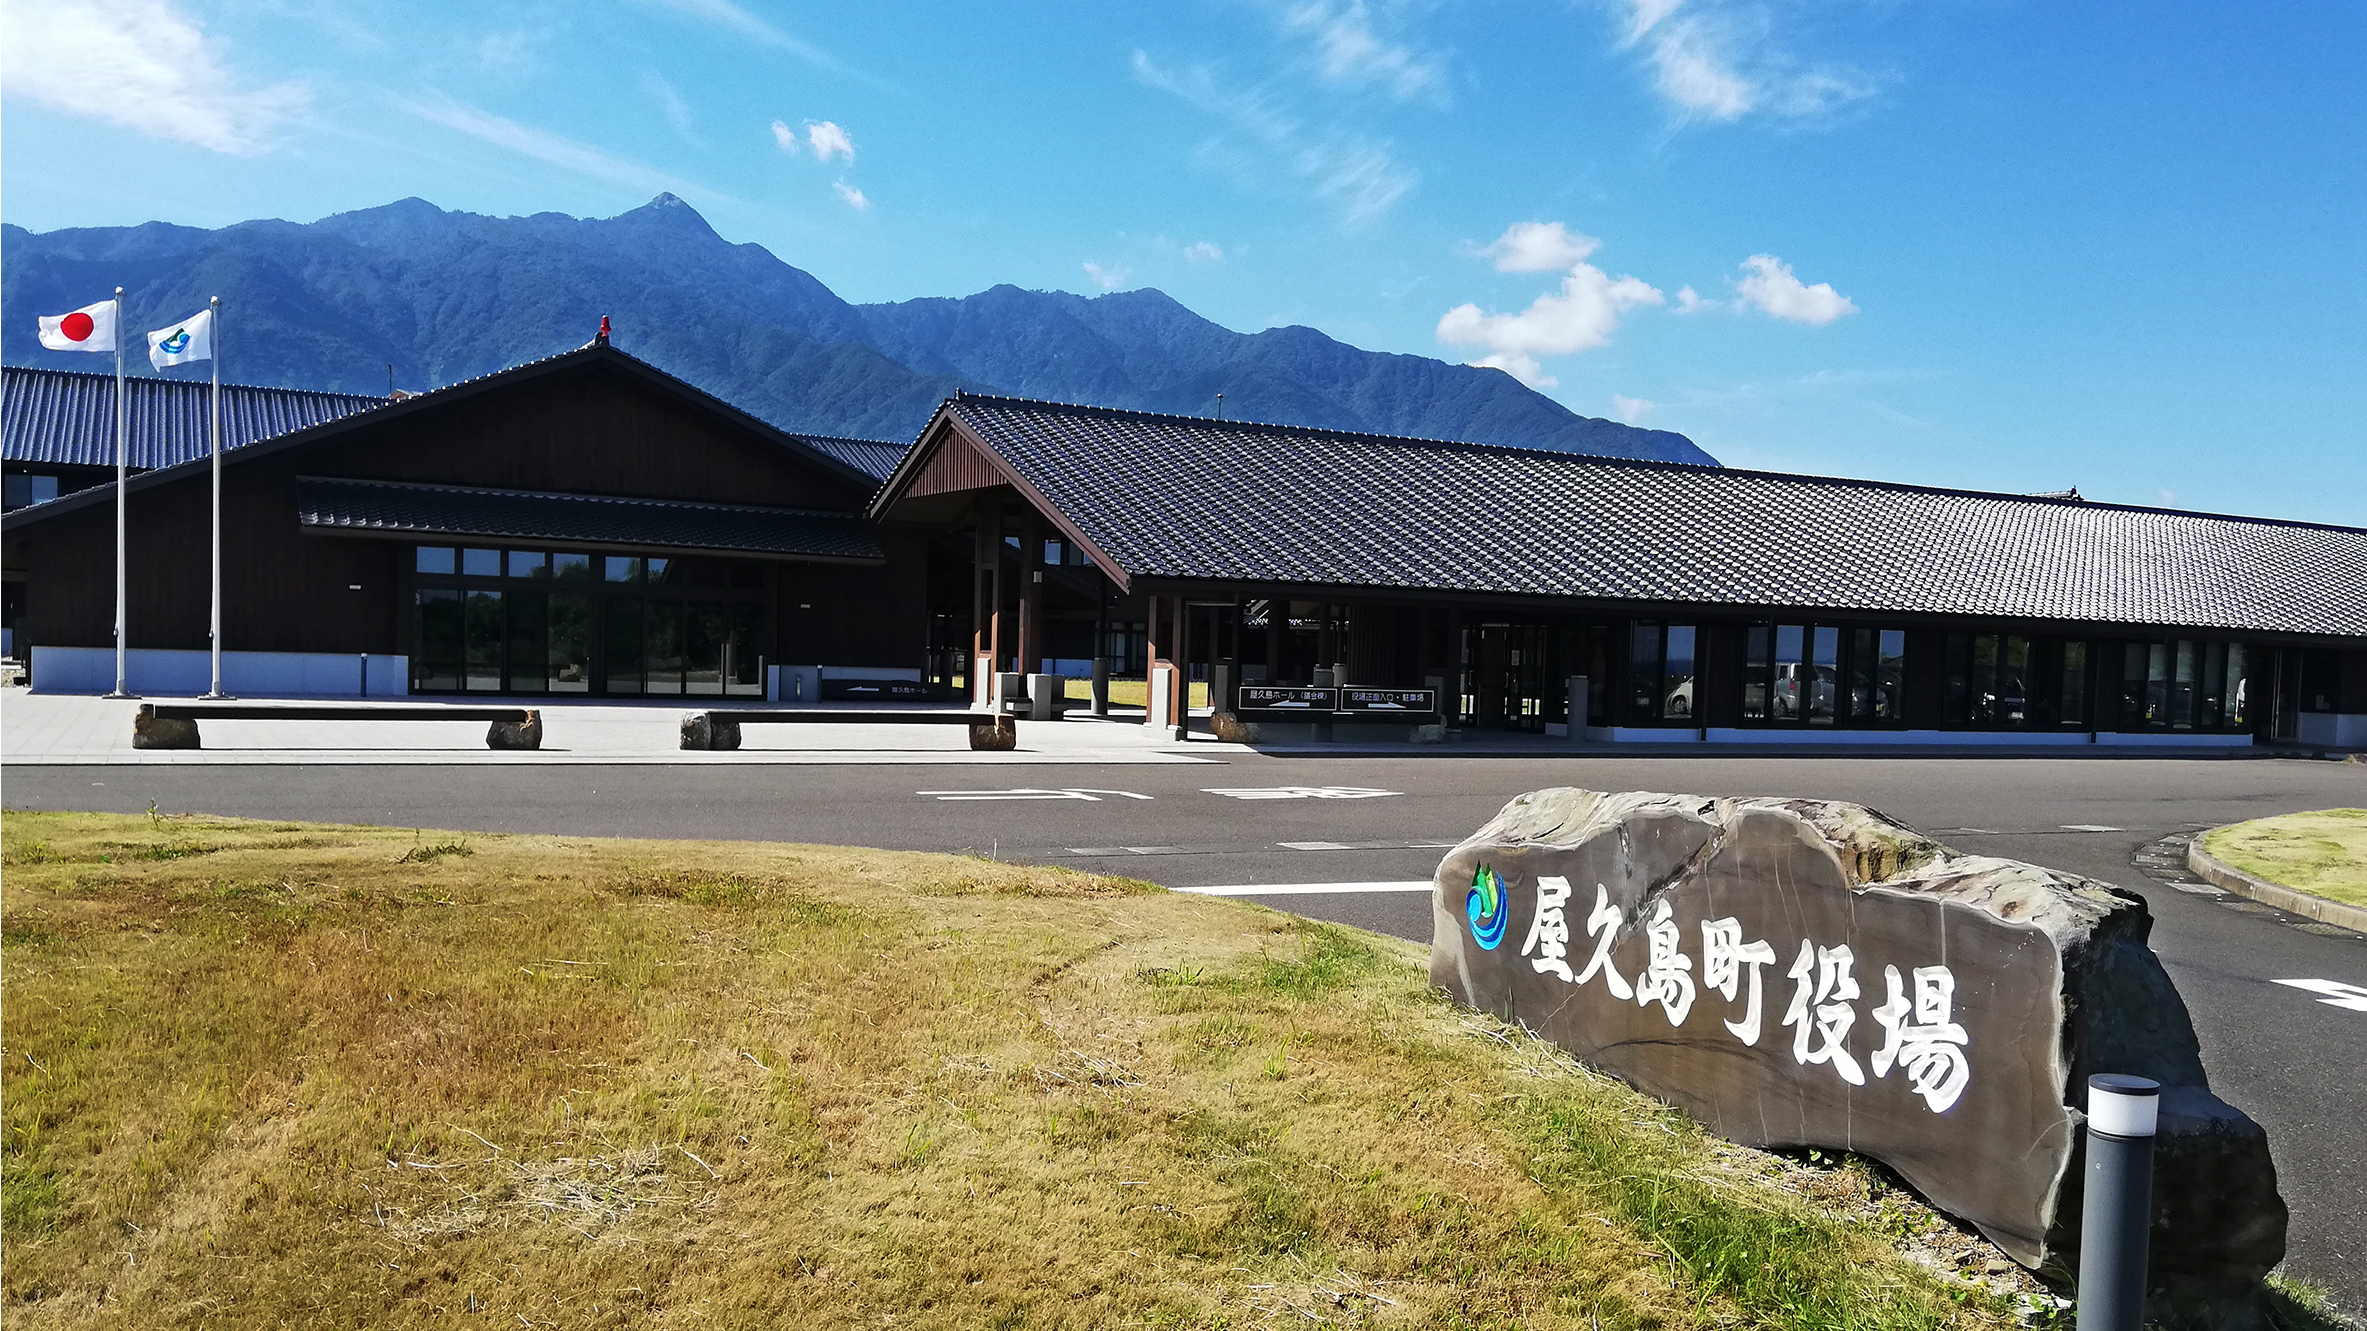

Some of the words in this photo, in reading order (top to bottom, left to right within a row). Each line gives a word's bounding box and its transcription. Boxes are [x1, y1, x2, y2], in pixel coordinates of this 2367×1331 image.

[1521, 875, 1971, 1114] 屋久島町役場
